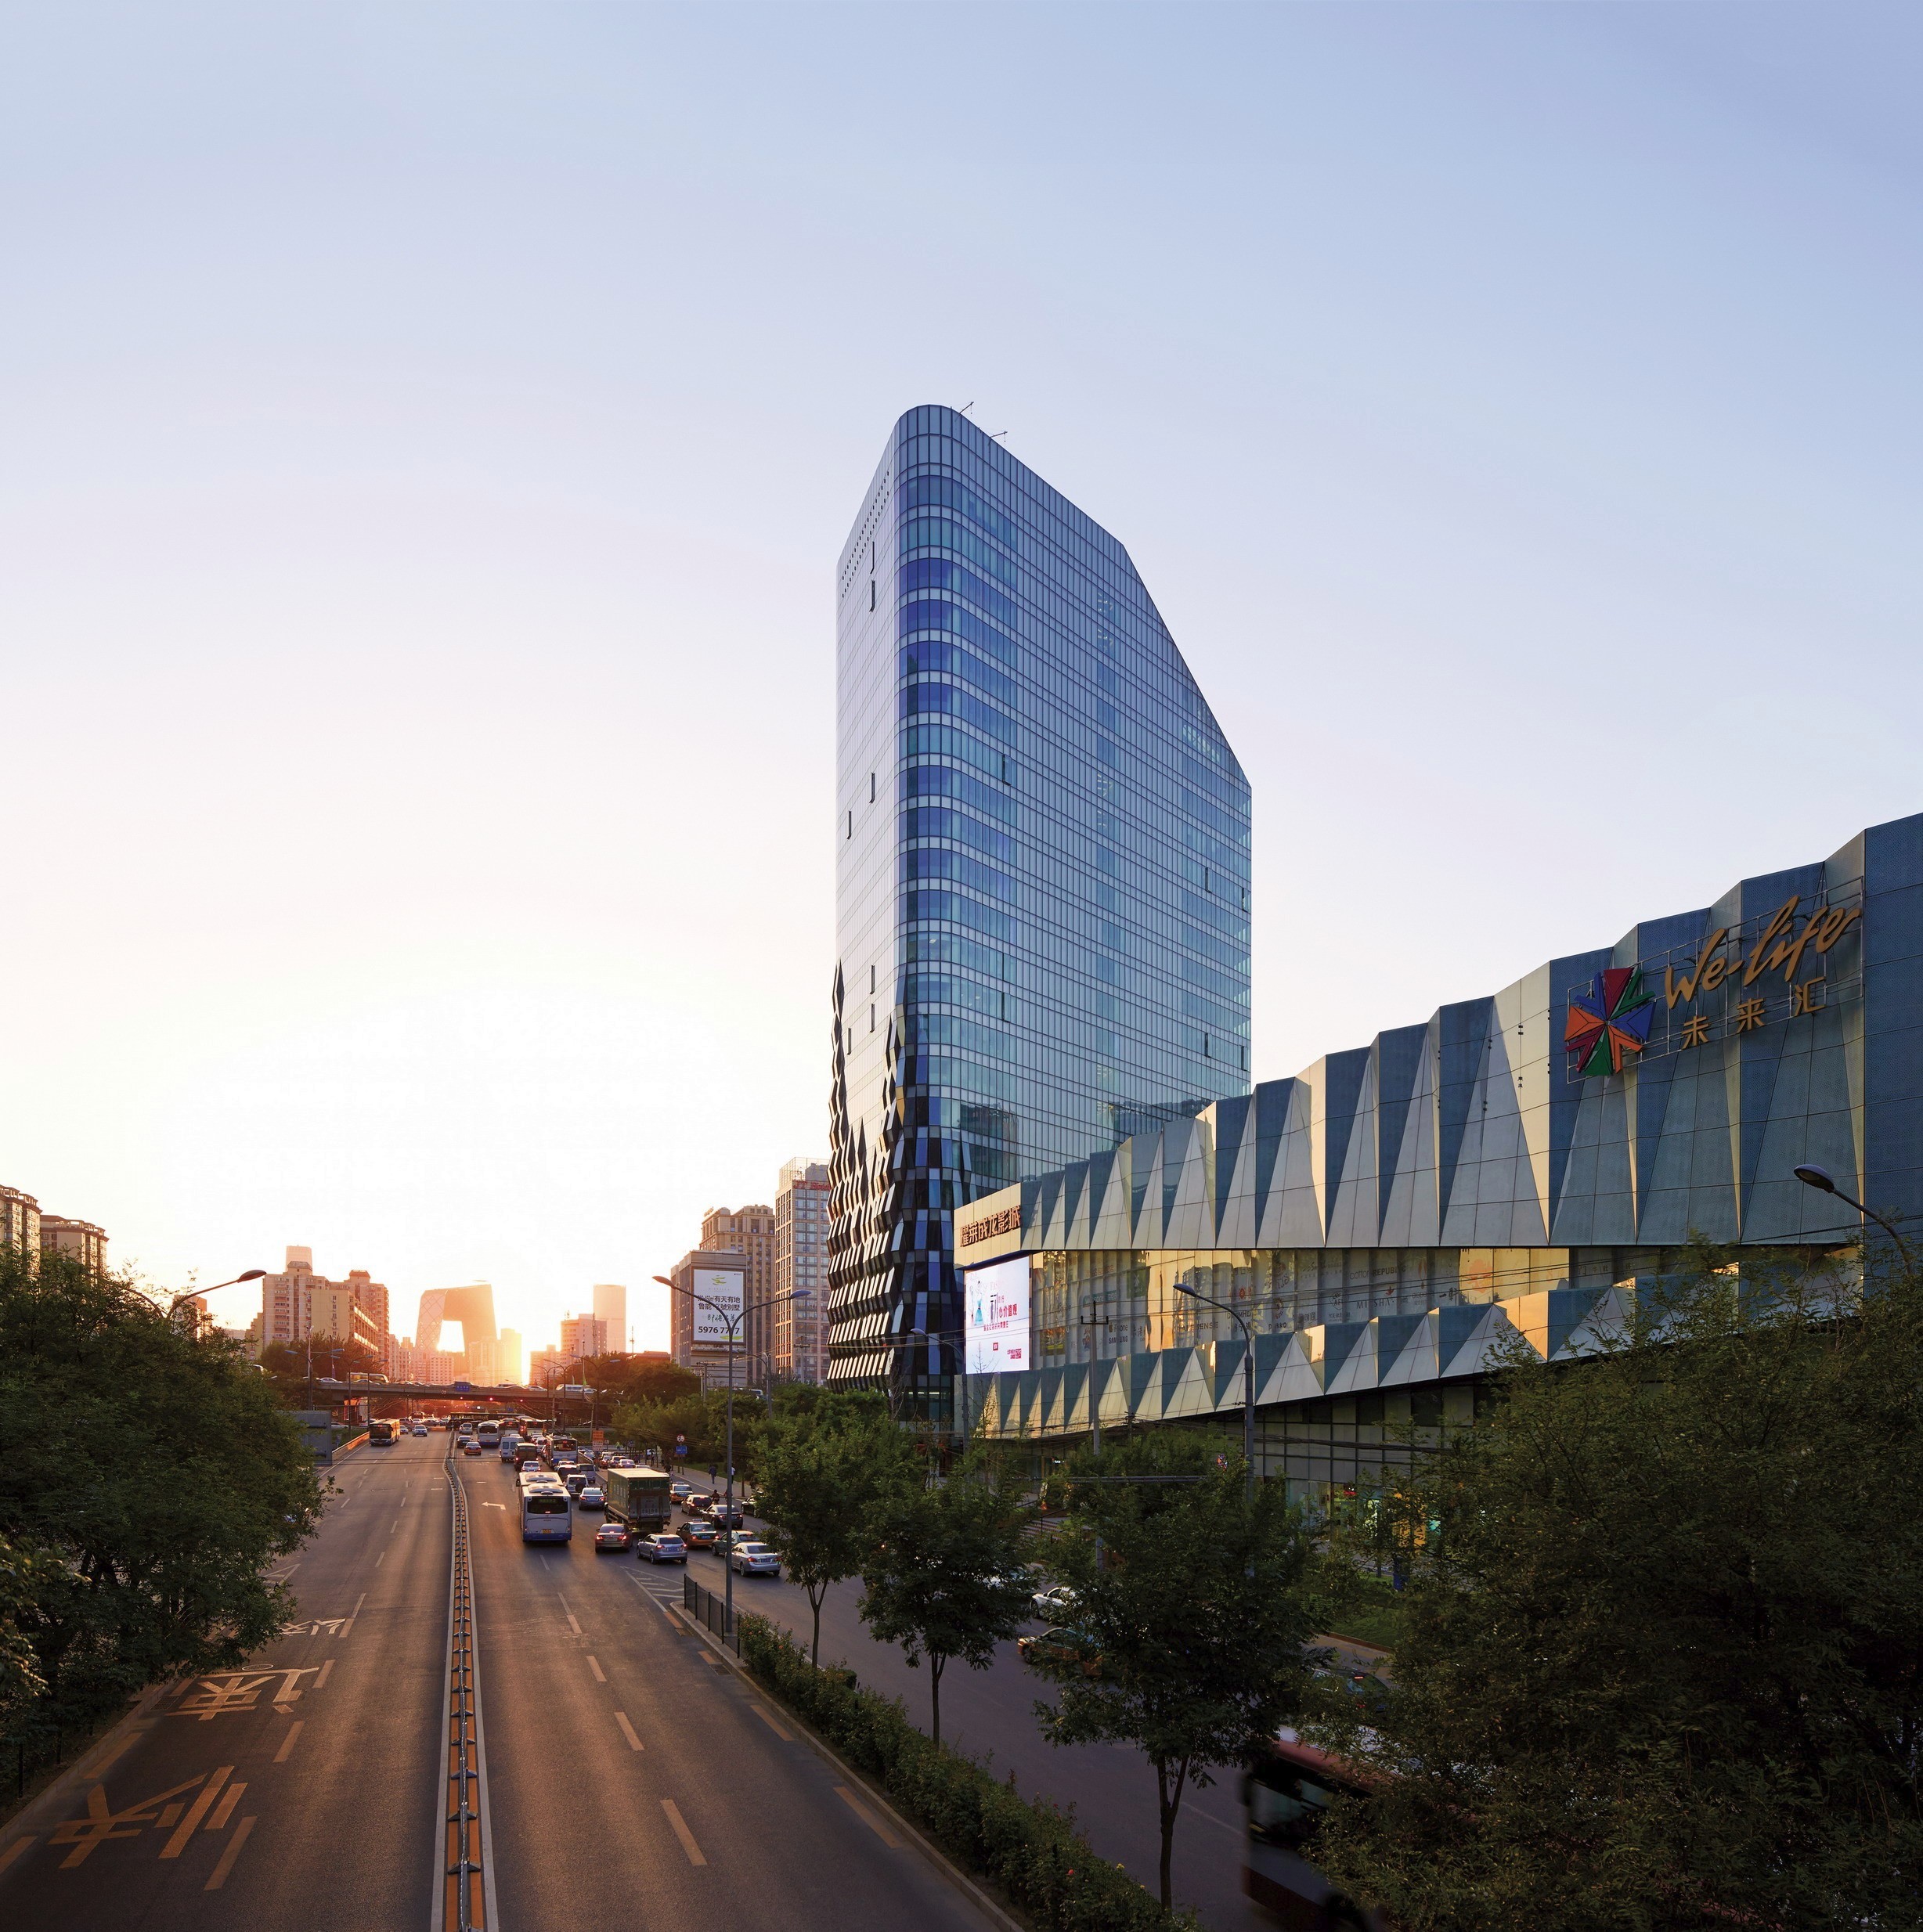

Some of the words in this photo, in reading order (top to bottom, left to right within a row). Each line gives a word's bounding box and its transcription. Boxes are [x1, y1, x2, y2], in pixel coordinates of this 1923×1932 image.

[1682, 976, 1827, 1050] 未来汇
[1373, 1265, 1406, 1277] REPUBLC
